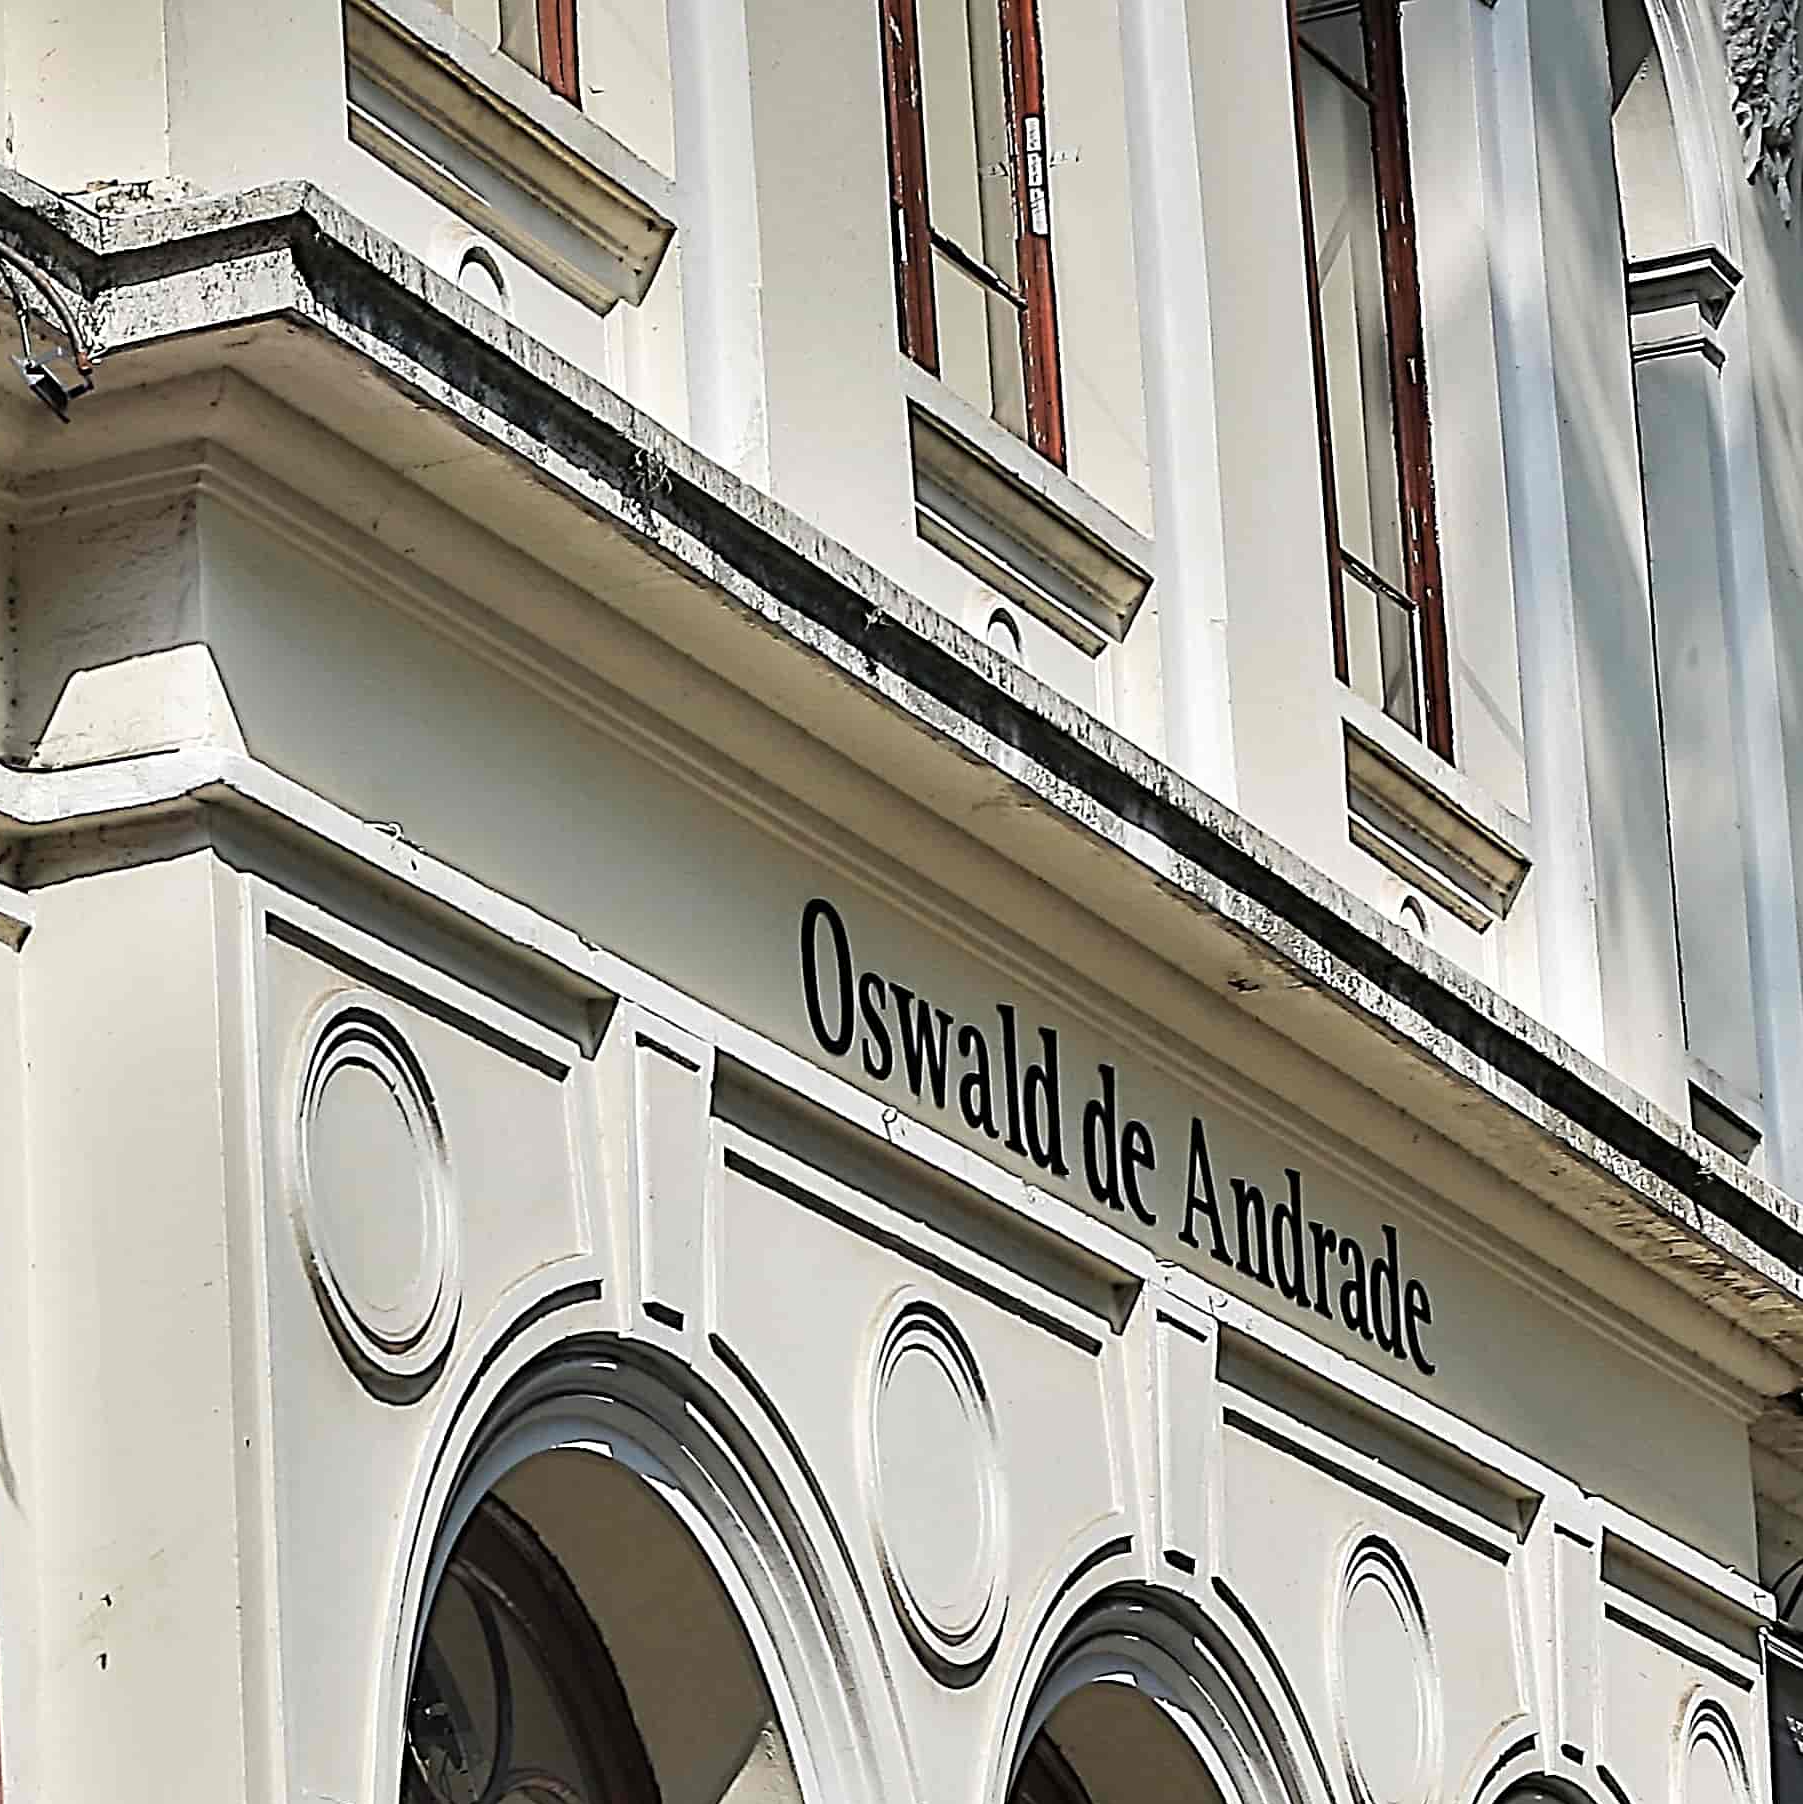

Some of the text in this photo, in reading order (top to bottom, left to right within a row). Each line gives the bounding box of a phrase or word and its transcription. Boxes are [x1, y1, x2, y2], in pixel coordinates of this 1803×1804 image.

[801, 898, 1436, 1377] Oswald de Andrade
